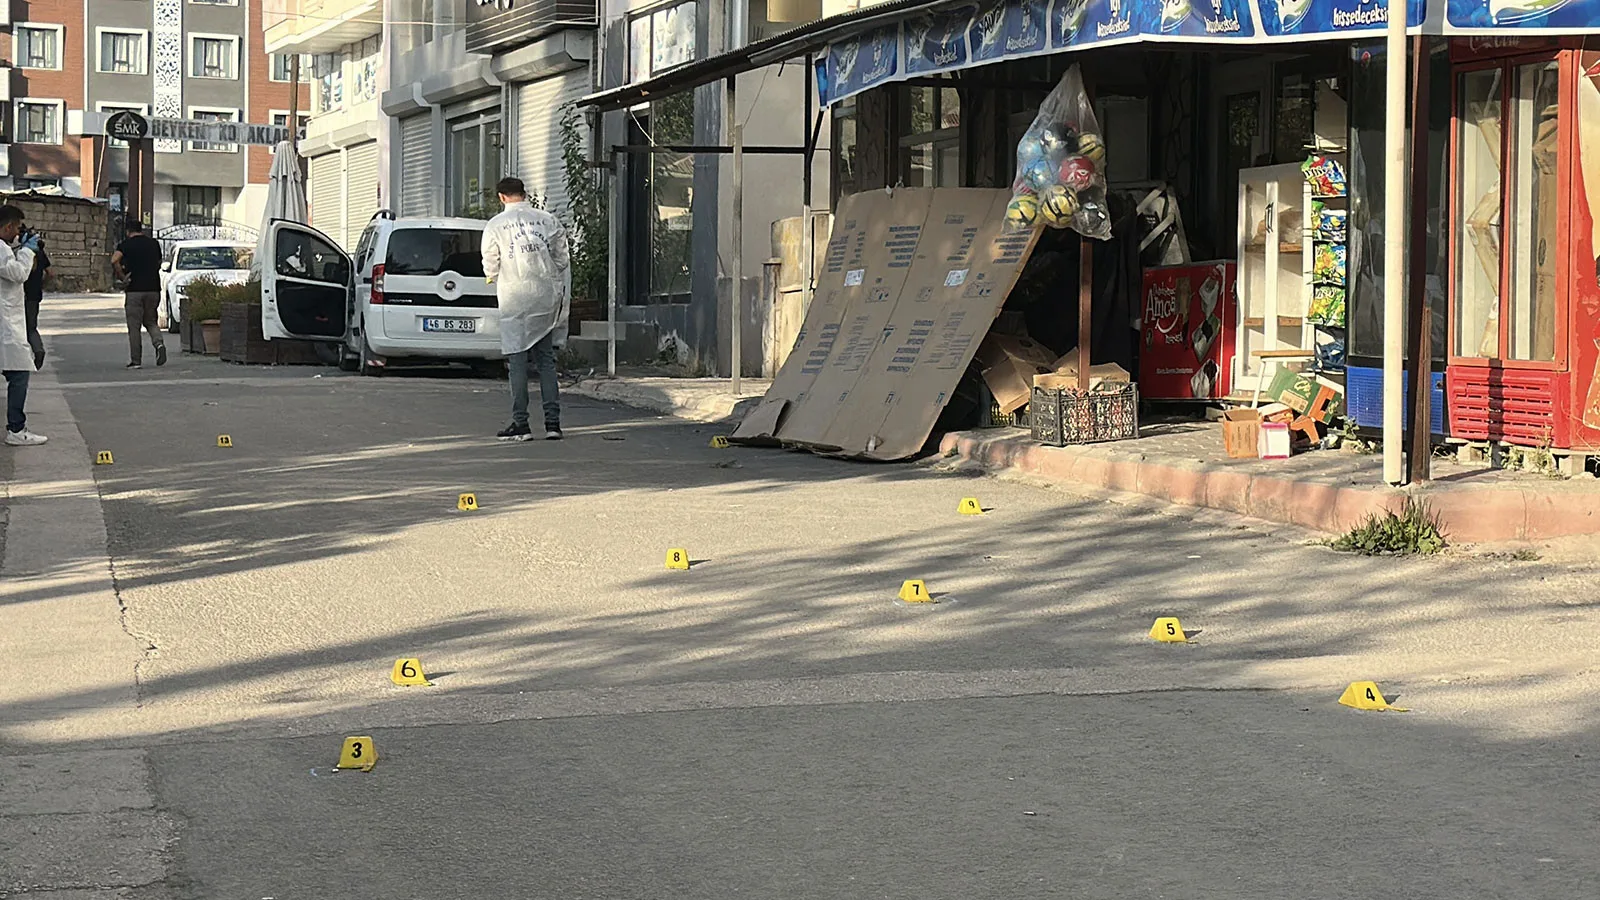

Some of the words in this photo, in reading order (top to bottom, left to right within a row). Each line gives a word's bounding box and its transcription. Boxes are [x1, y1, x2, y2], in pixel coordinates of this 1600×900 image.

[114, 123, 140, 135] SMK
[429, 319, 440, 329] 46
[444, 319, 454, 329] BS
[458, 320, 474, 329] 283
[219, 436, 230, 444] 13
[99, 452, 109, 460] 11
[968, 500, 975, 508] 9
[673, 551, 680, 562] 8
[912, 584, 920, 595] 7
[1166, 622, 1176, 635] 5
[401, 660, 417, 678] 6
[1366, 687, 1376, 701] 4
[351, 741, 363, 759] 3
